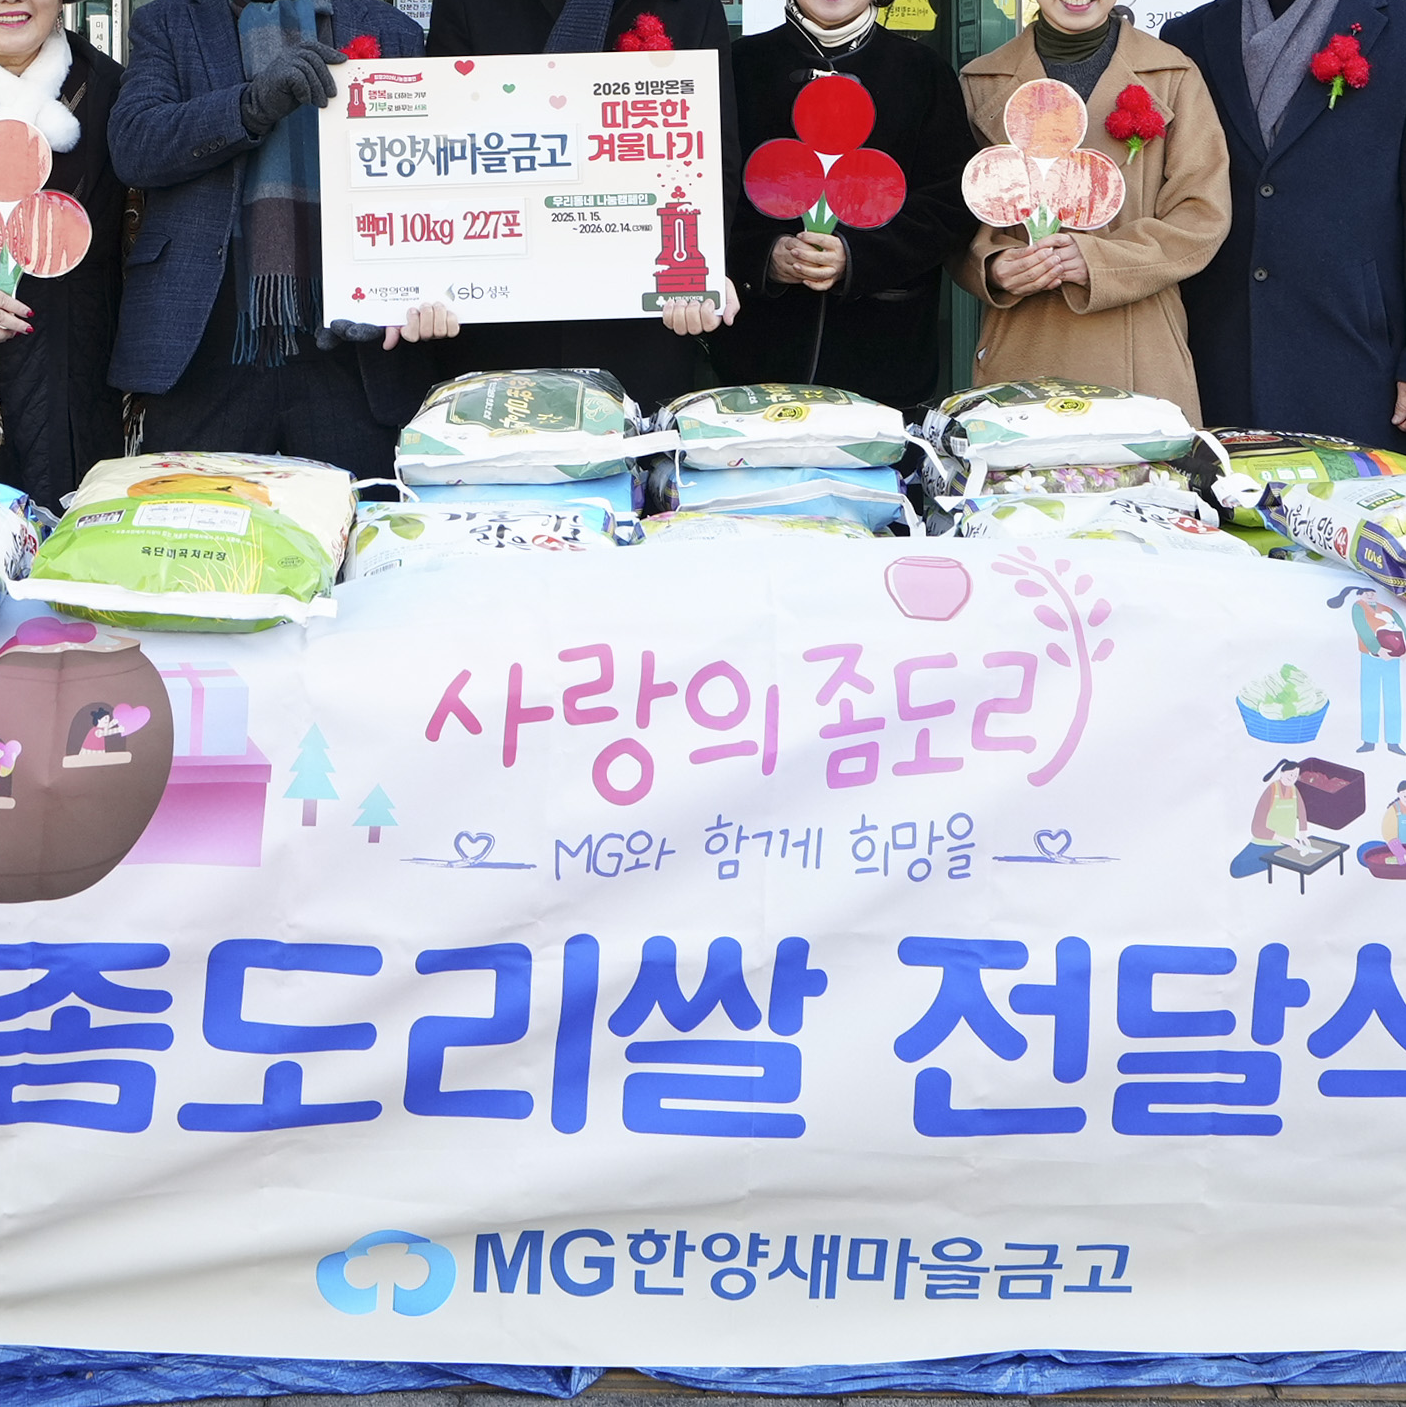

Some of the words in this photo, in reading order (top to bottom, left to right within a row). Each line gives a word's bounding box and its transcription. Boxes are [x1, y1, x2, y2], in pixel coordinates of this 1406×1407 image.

[368, 90, 393, 100] 행복을
[593, 82, 630, 96] 2026
[635, 79, 695, 96] 희망온돌
[369, 102, 393, 112] 기부로
[394, 104, 413, 112] 바꾸는
[601, 99, 689, 130] 따뜻한
[356, 132, 572, 178] 한양새마을금고
[587, 131, 704, 162] 겨울나기
[552, 195, 594, 207] 우리동네
[596, 193, 649, 206] 나눔캠페인
[356, 211, 394, 247] 백미
[401, 212, 454, 245] 10kg
[463, 209, 523, 241] 227포
[457, 283, 484, 300] sb
[487, 285, 510, 299] 성북
[424, 643, 780, 807] 사랑의
[801, 634, 1093, 789] 좀도리
[554, 829, 676, 880] MG와
[704, 813, 824, 879] 함께
[849, 812, 975, 882] 희망을
[471, 1228, 1134, 1305] MG한양새마을금고
